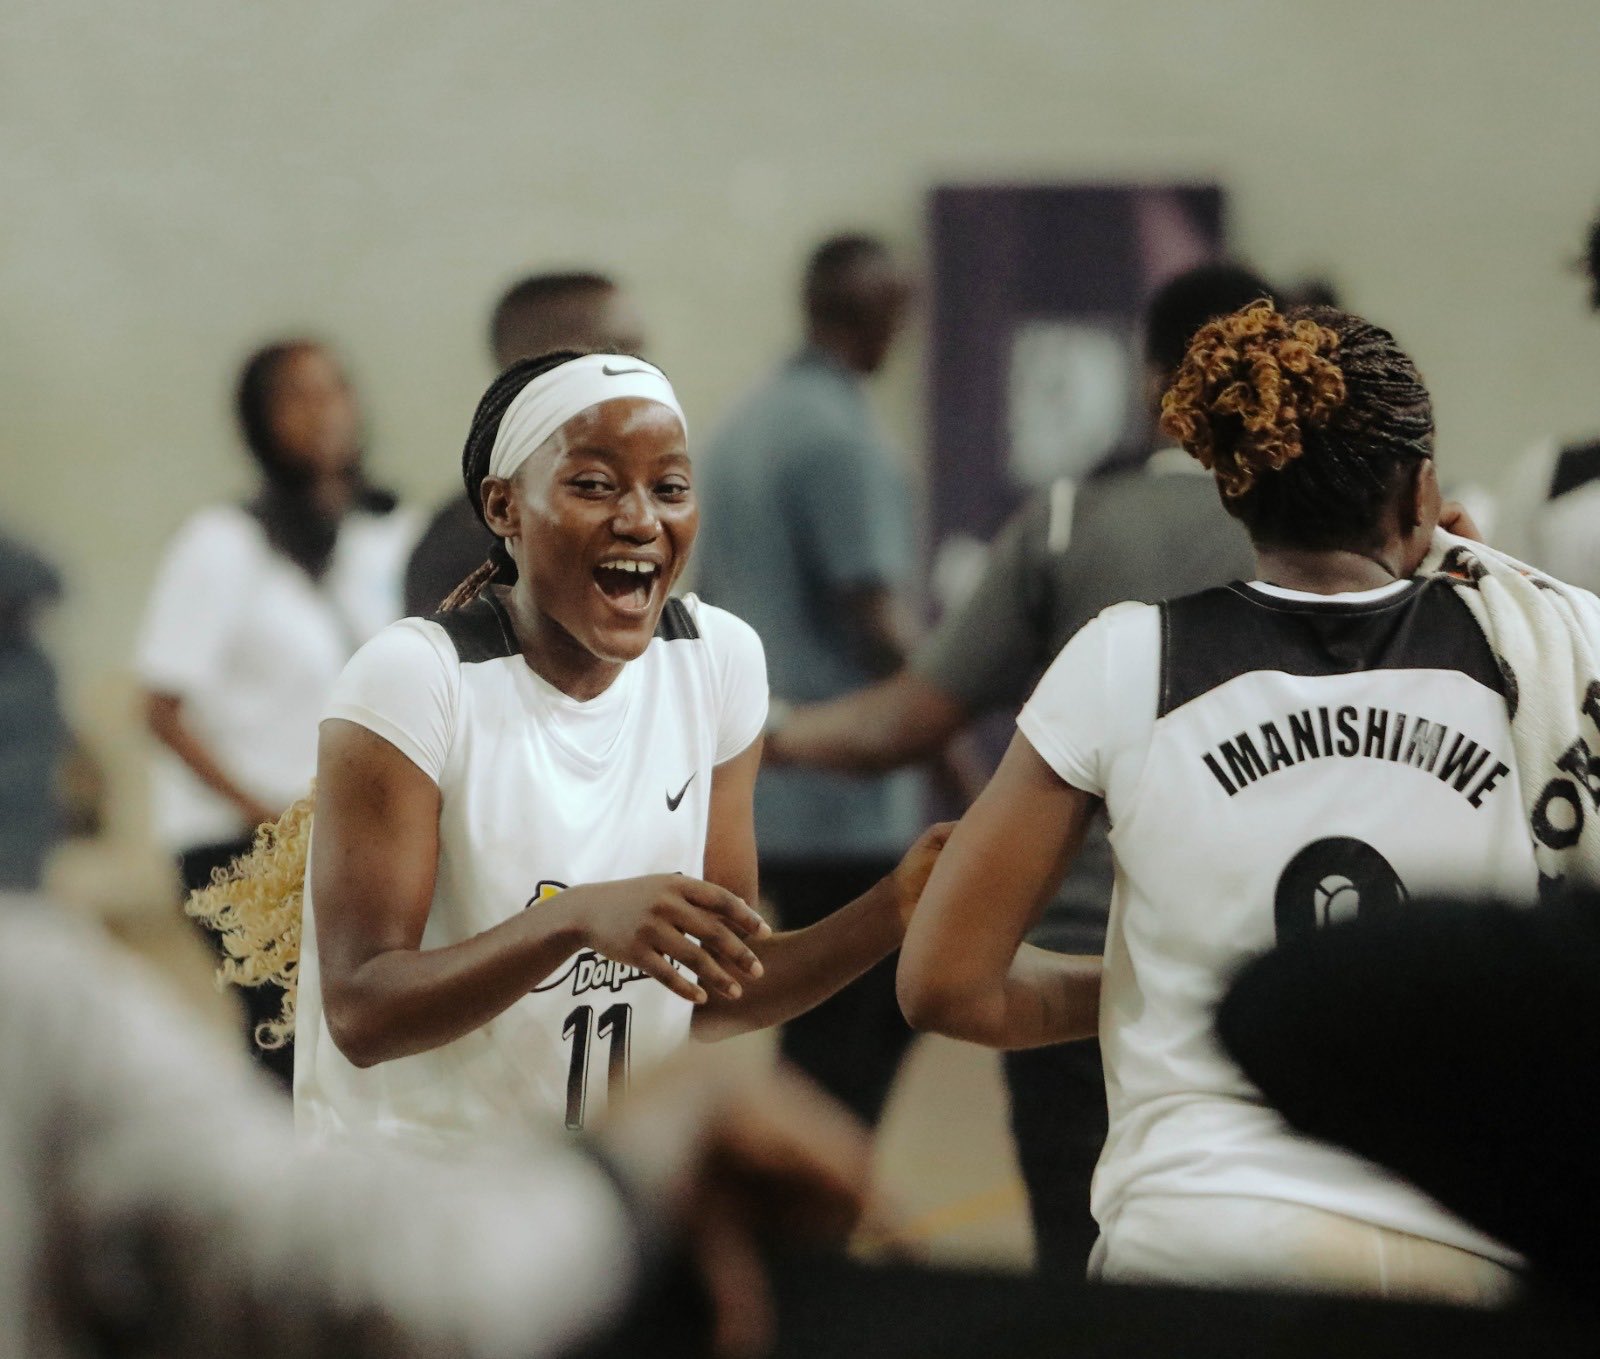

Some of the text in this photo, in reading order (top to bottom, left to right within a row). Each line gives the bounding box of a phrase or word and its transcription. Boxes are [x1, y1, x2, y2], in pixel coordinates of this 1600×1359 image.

[1202, 706, 1510, 809] IMANISHIMWE
[572, 953, 655, 996] Dolp
[562, 1003, 632, 1130] 11
